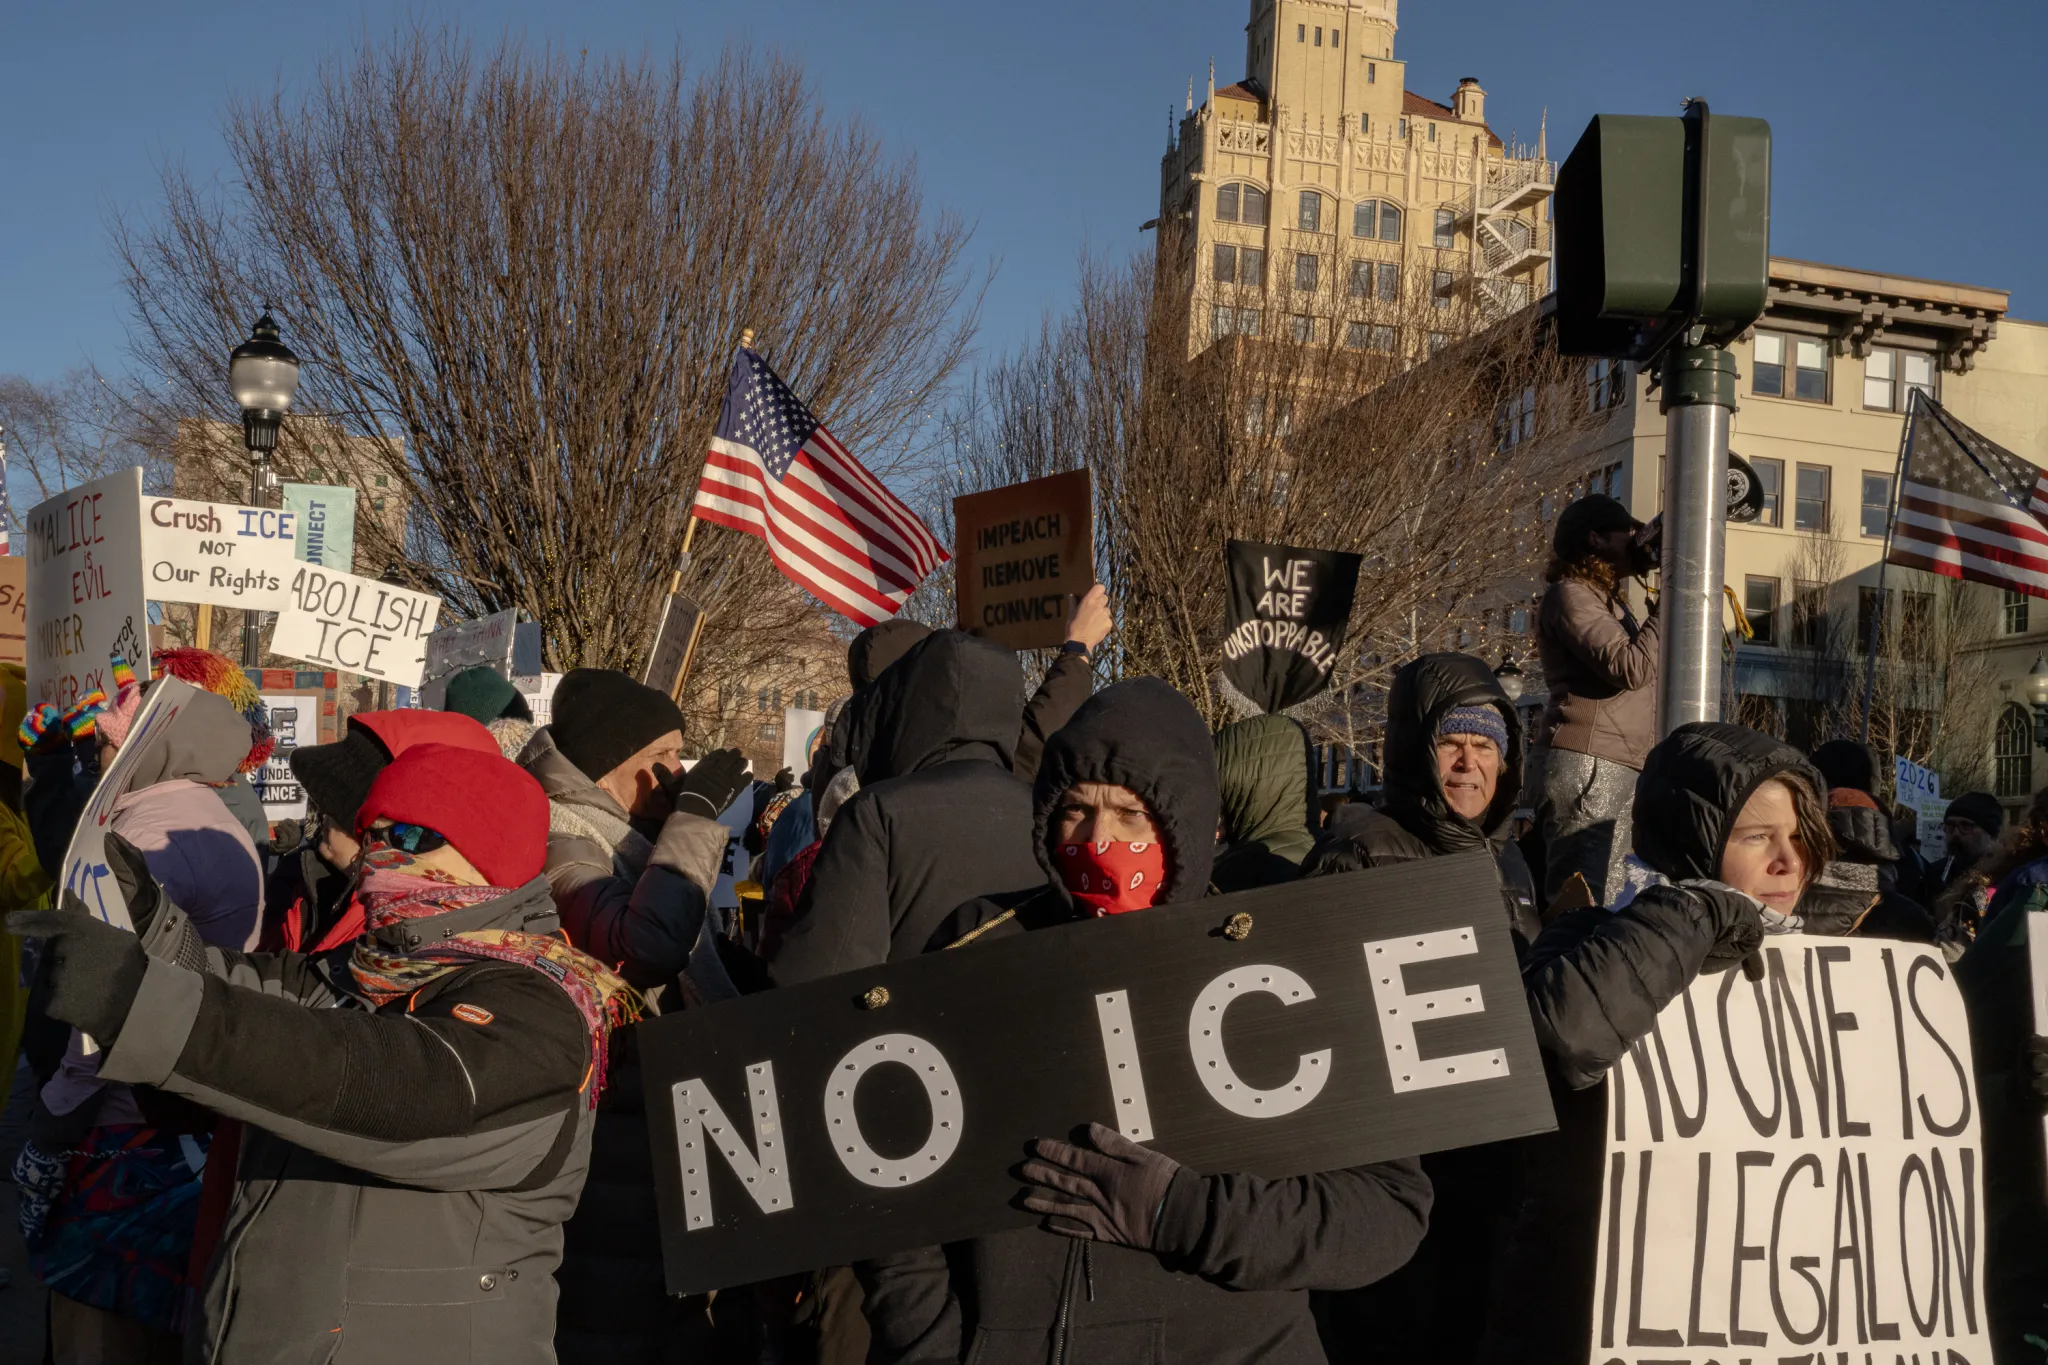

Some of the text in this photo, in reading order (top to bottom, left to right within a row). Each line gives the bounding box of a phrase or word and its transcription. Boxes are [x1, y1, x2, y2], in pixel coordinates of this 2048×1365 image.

[33, 493, 105, 567] MALICE
[151, 500, 294, 539] Crush ICE
[307, 500, 326, 566] ONNECT
[977, 514, 1061, 550] IMPEACH
[199, 540, 236, 557] NOT
[72, 565, 112, 604] EVIL
[152, 561, 280, 596] Our Rights
[982, 554, 1060, 588] REMOVE
[1264, 557, 1313, 592] WE
[292, 567, 428, 640] ABOLISH
[983, 594, 1064, 627] CONVICT
[1256, 591, 1305, 617] ARE
[113, 615, 134, 655] STOP
[125, 634, 142, 667] CE
[305, 617, 392, 676] ICE
[1223, 619, 1336, 677] UNSTOPPABLE
[1899, 761, 1935, 794] 2026
[1613, 946, 1972, 1142] NO ONE IS
[672, 926, 1511, 1231] NO ICE
[1601, 1146, 1979, 1349] ILLEGAL ON
